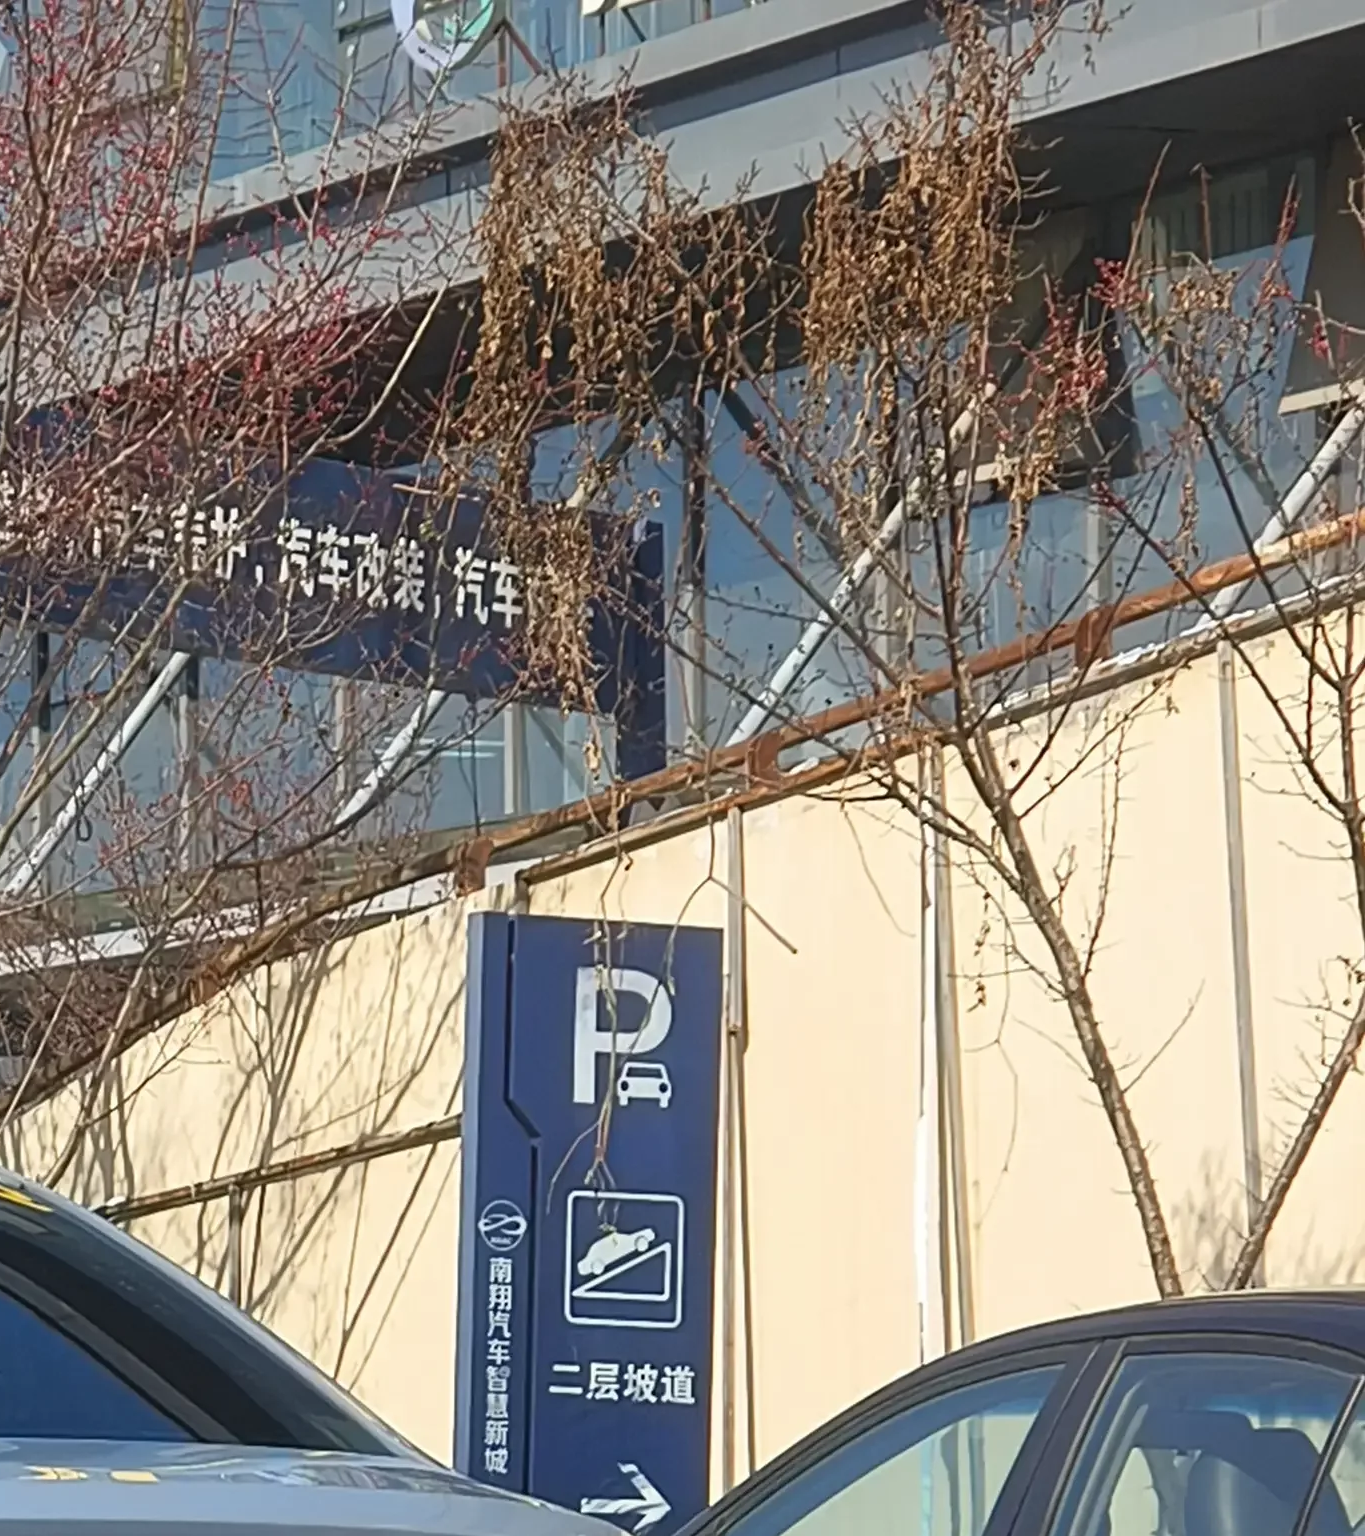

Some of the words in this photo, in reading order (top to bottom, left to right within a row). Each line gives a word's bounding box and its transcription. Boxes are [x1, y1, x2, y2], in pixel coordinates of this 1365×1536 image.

[573, 966, 672, 1104] P
[484, 1256, 513, 1475] 南翔汽车智慧新城
[548, 1361, 696, 1405] 二层坡道
